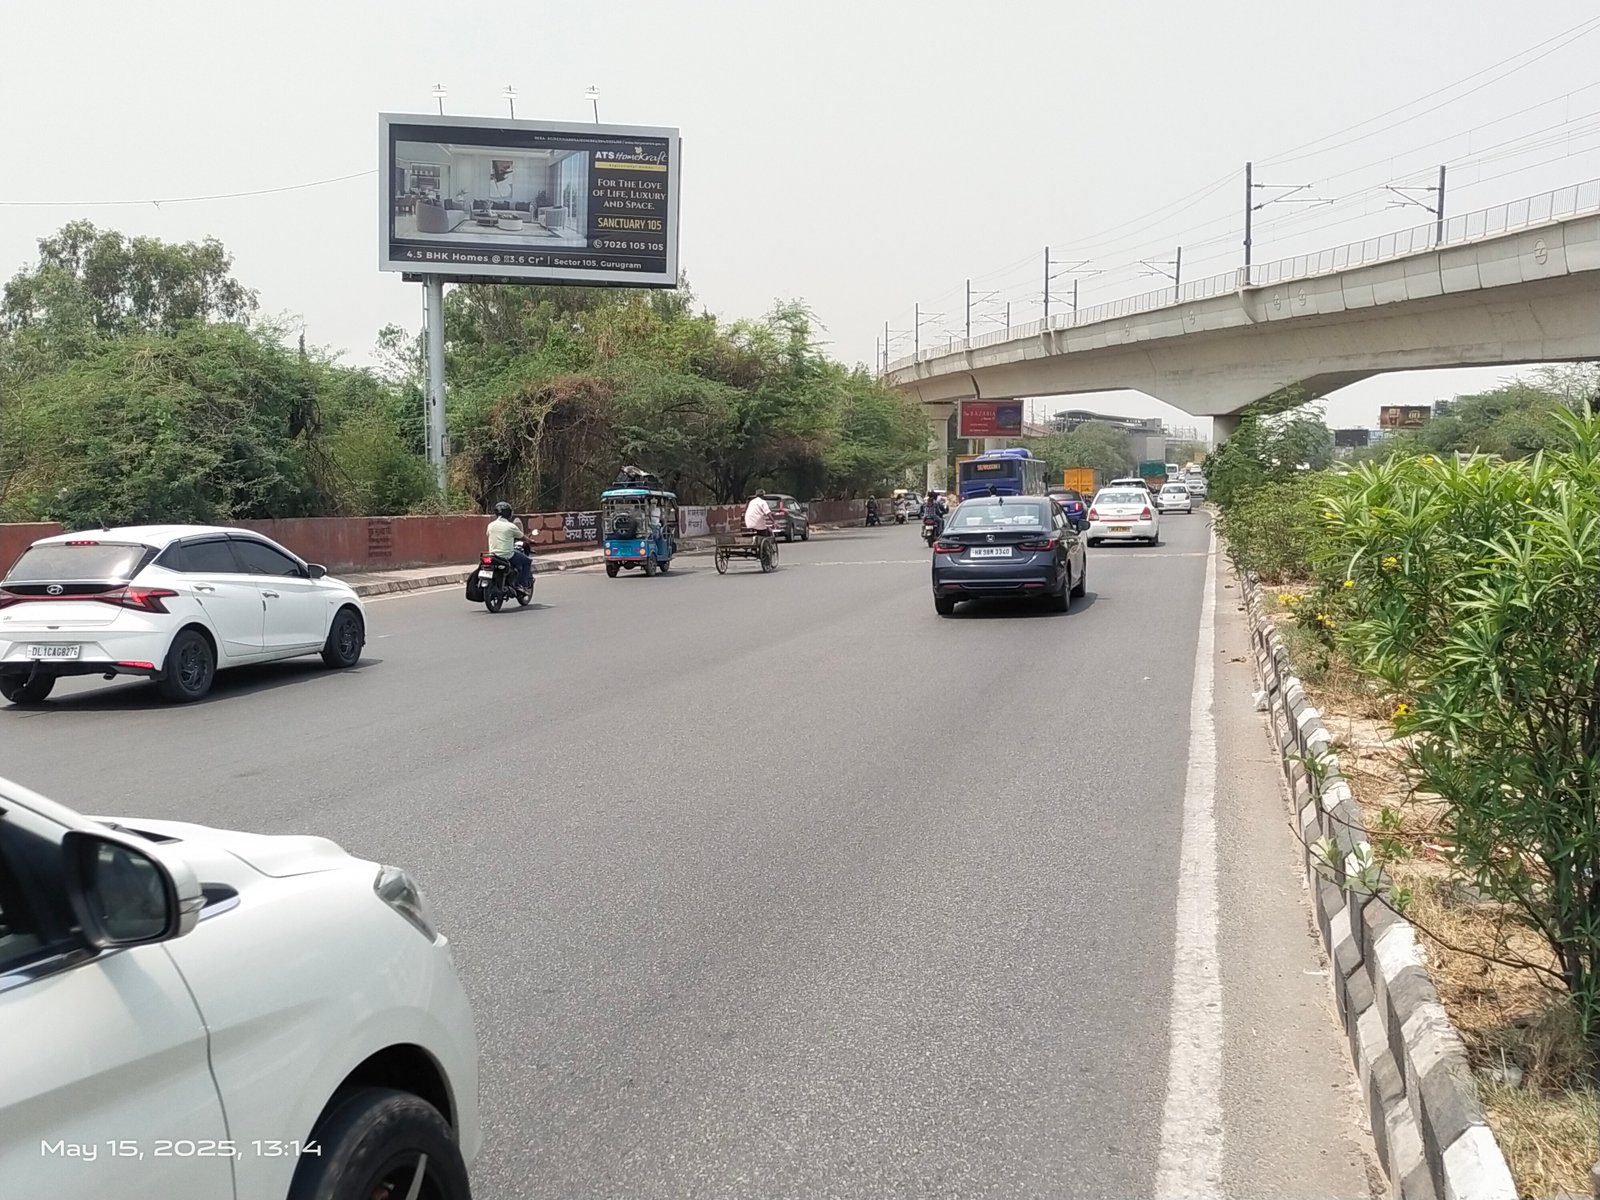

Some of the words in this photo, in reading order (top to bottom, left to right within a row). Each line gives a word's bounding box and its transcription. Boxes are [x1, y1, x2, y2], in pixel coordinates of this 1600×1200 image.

[595, 151, 615, 160] ATS
[597, 217, 646, 230] SANCTUARY
[647, 220, 662, 231] 105
[603, 240, 628, 249] 7026
[629, 241, 646, 250] 105
[648, 242, 664, 251] 105
[406, 250, 423, 259] 4.5
[426, 251, 449, 260] BHK
[452, 252, 489, 262] Homes
[491, 254, 501, 264] @
[554, 258, 581, 266] Sector
[600, 260, 642, 270] Gurugram
